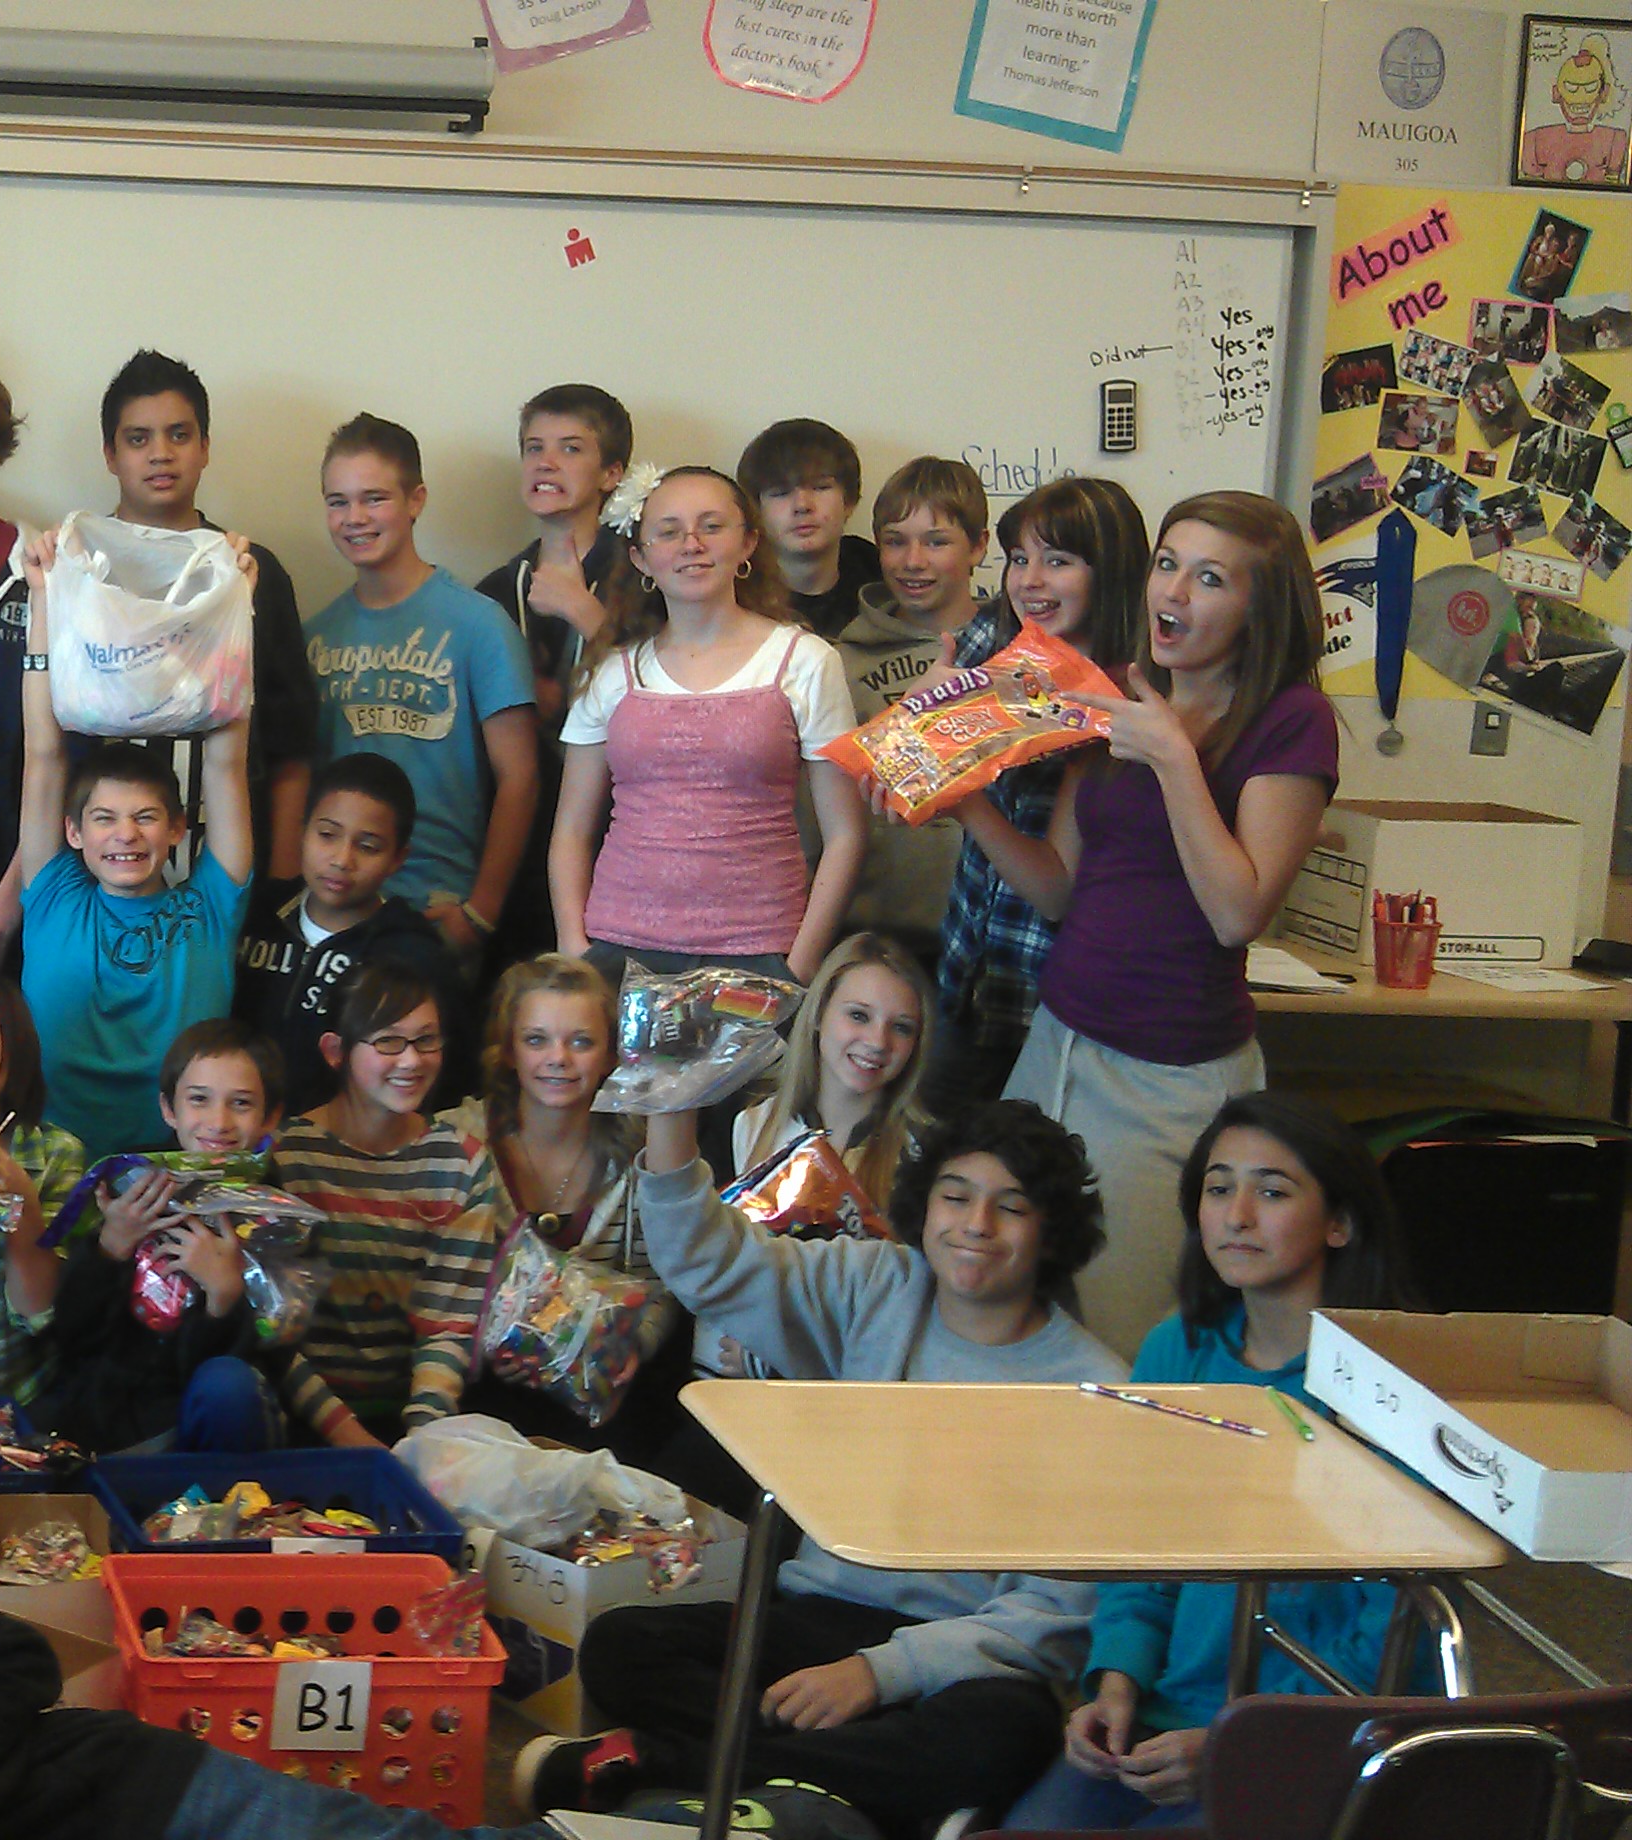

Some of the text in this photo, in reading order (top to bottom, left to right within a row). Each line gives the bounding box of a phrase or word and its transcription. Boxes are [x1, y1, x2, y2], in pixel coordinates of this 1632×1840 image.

[530, 0, 602, 28] Doug Larson
[805, 6, 829, 21] are
[830, 9, 854, 27] the
[1063, 2, 1074, 17] is
[1077, 9, 1117, 27] worth
[1078, 0, 1133, 14] ecause
[734, 14, 845, 52] best cures in the
[1025, 22, 1097, 49] more than
[731, 43, 784, 68] doctor's
[1002, 66, 1100, 100] Thomas Jefferson
[1356, 120, 1459, 145] MAUIGOA
[1394, 157, 1419, 172] 305
[1175, 238, 1197, 264] A1
[1337, 207, 1451, 299] About
[1173, 270, 1203, 290] A2
[1386, 279, 1449, 331] me
[1089, 345, 1123, 367] Did
[305, 627, 455, 684] Aeropostale
[392, 709, 428, 732] 1987
[297, 1682, 355, 1732] B1
